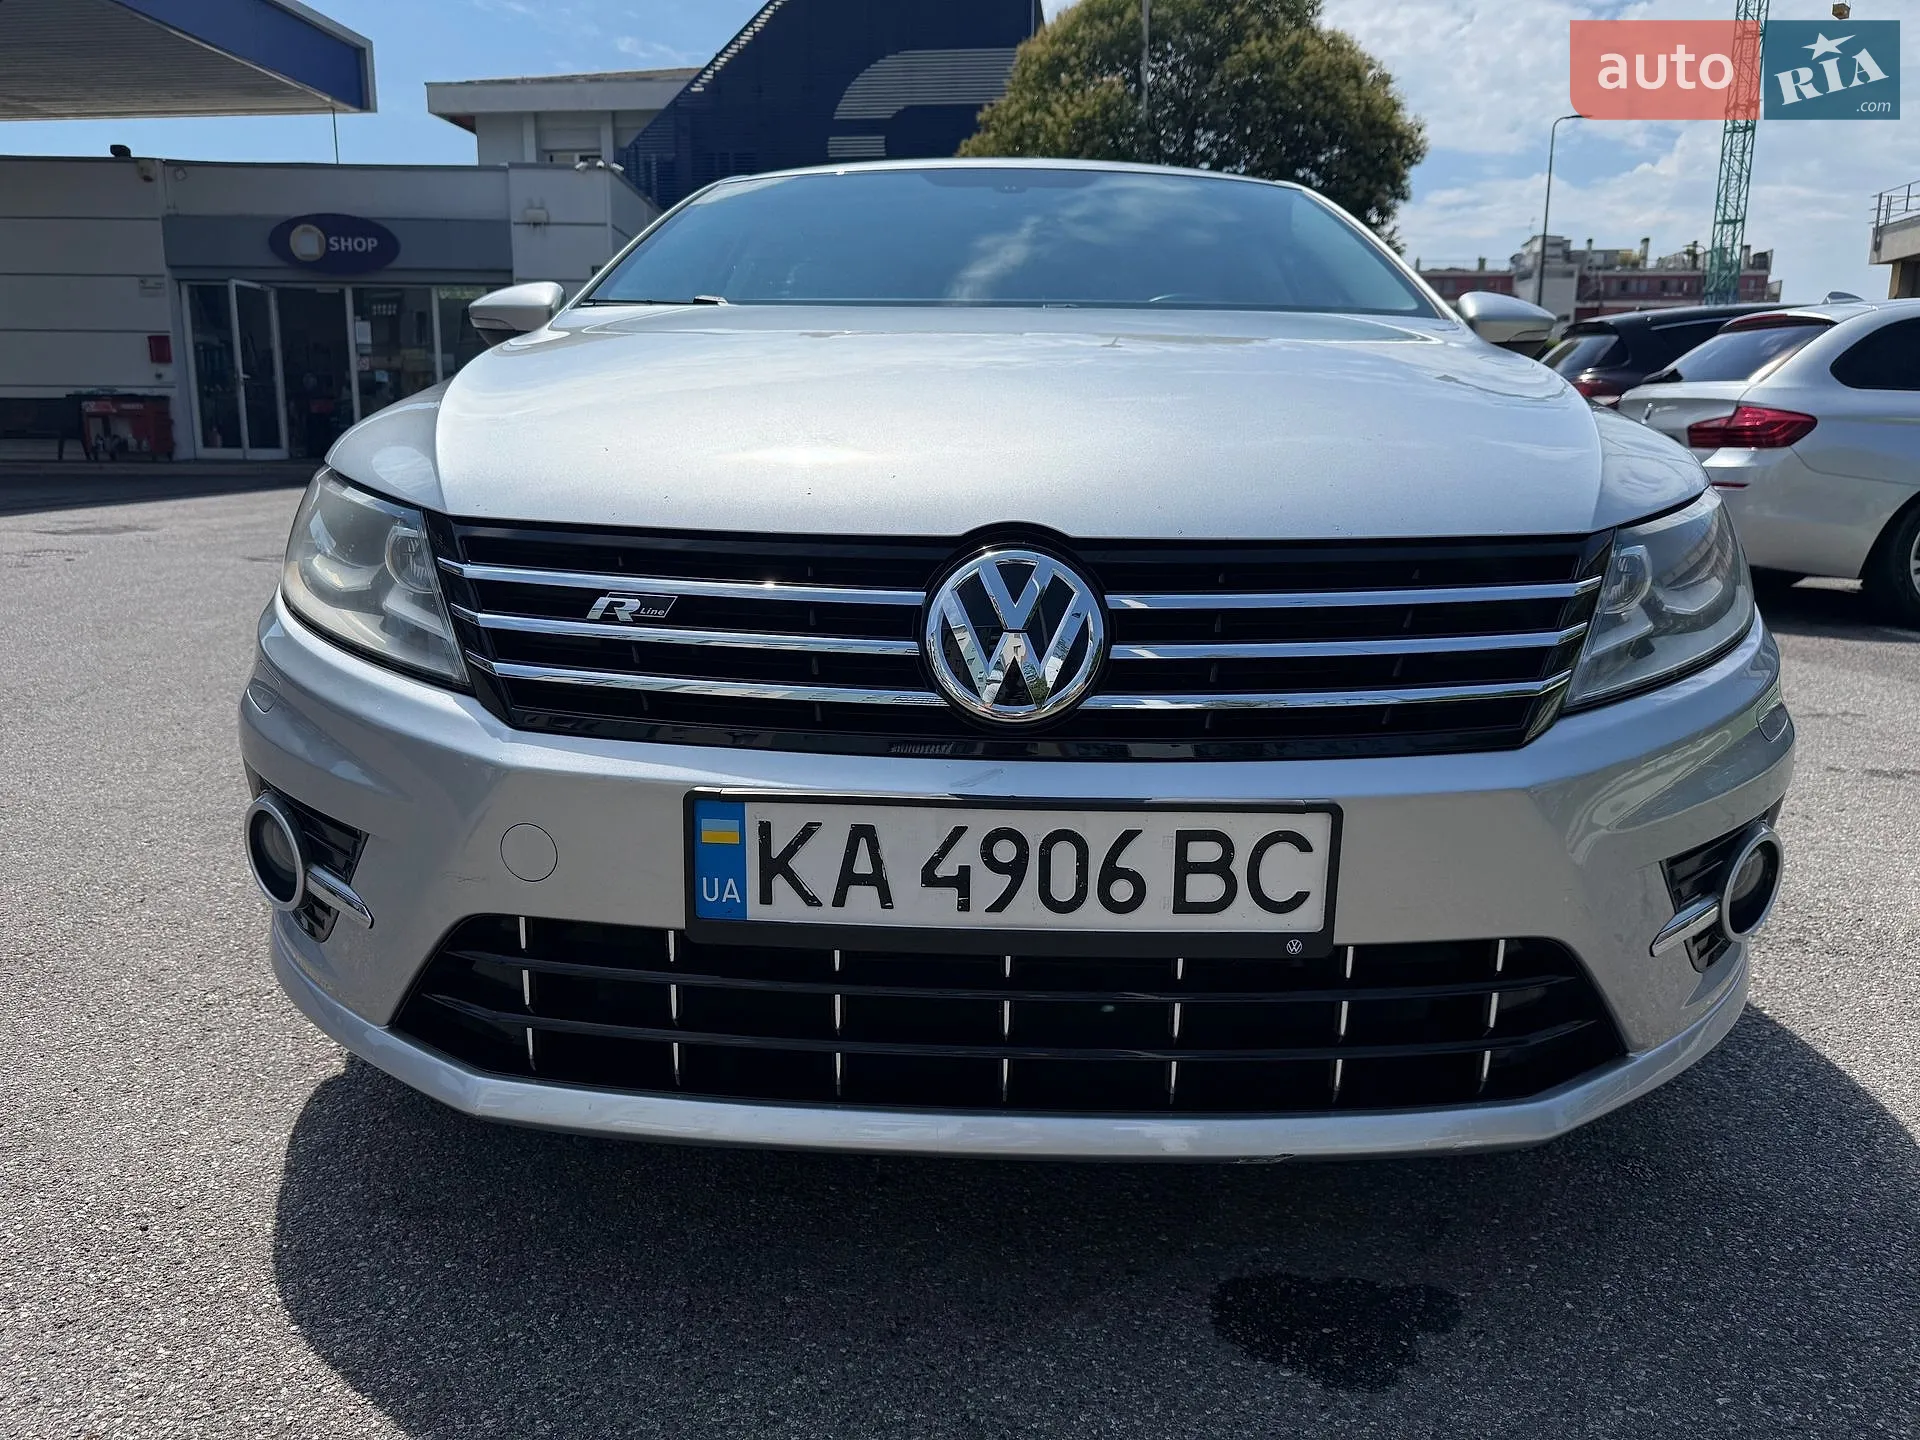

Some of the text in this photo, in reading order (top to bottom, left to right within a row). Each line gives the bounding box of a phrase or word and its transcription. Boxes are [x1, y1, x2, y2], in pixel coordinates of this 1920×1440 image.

[328, 236, 379, 252] SHOP
[586, 596, 665, 622] R Line
[757, 820, 1315, 915] KA 4906 BC
[702, 877, 741, 903] UA
